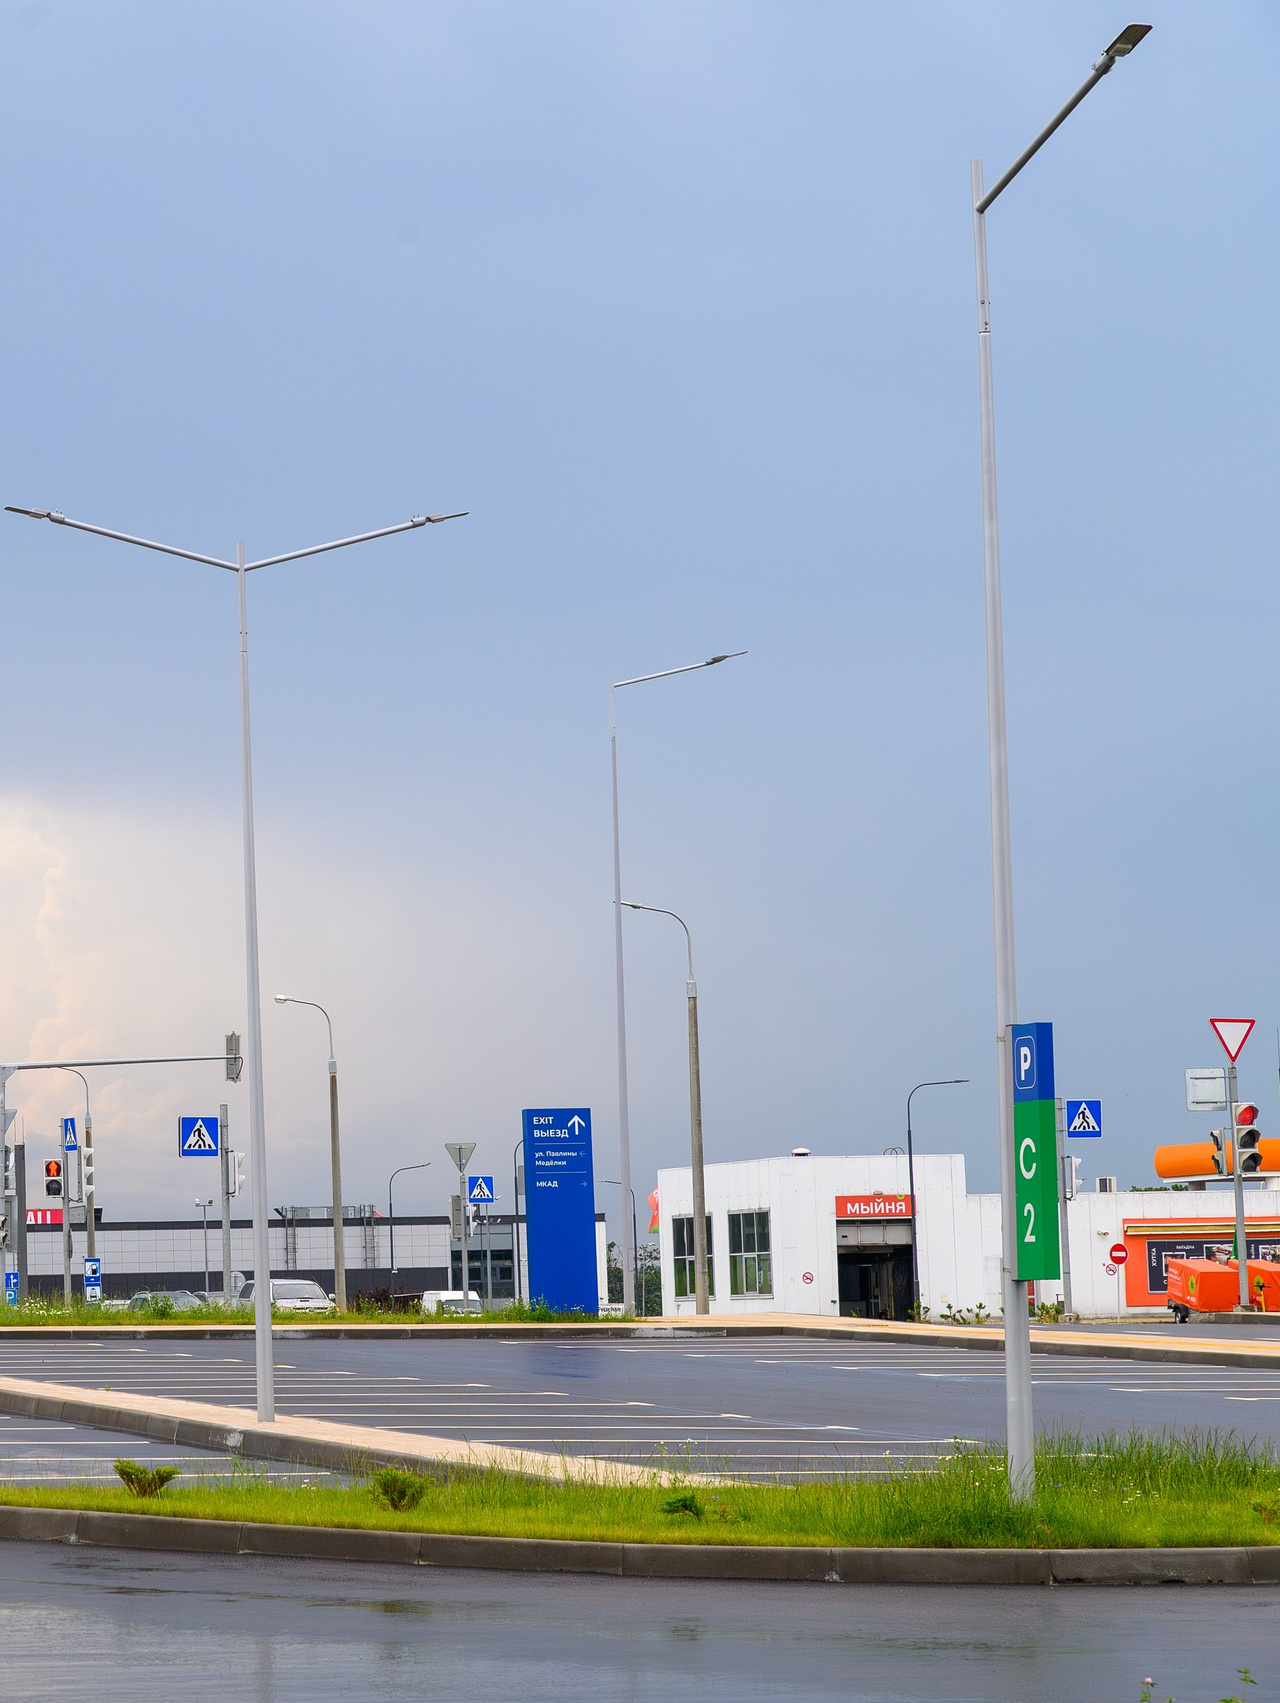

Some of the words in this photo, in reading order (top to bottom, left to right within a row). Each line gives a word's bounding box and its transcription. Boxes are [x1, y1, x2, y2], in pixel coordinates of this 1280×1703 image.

[1020, 1046, 1031, 1081] P
[533, 1117, 554, 1125] EXIT
[533, 1129, 569, 1138] ВЫЕЗД
[535, 1151, 545, 1159] ул.
[1019, 1137, 1036, 1180] C
[846, 1198, 906, 1215] МЫЙНЯ
[1023, 1202, 1036, 1243] 2
